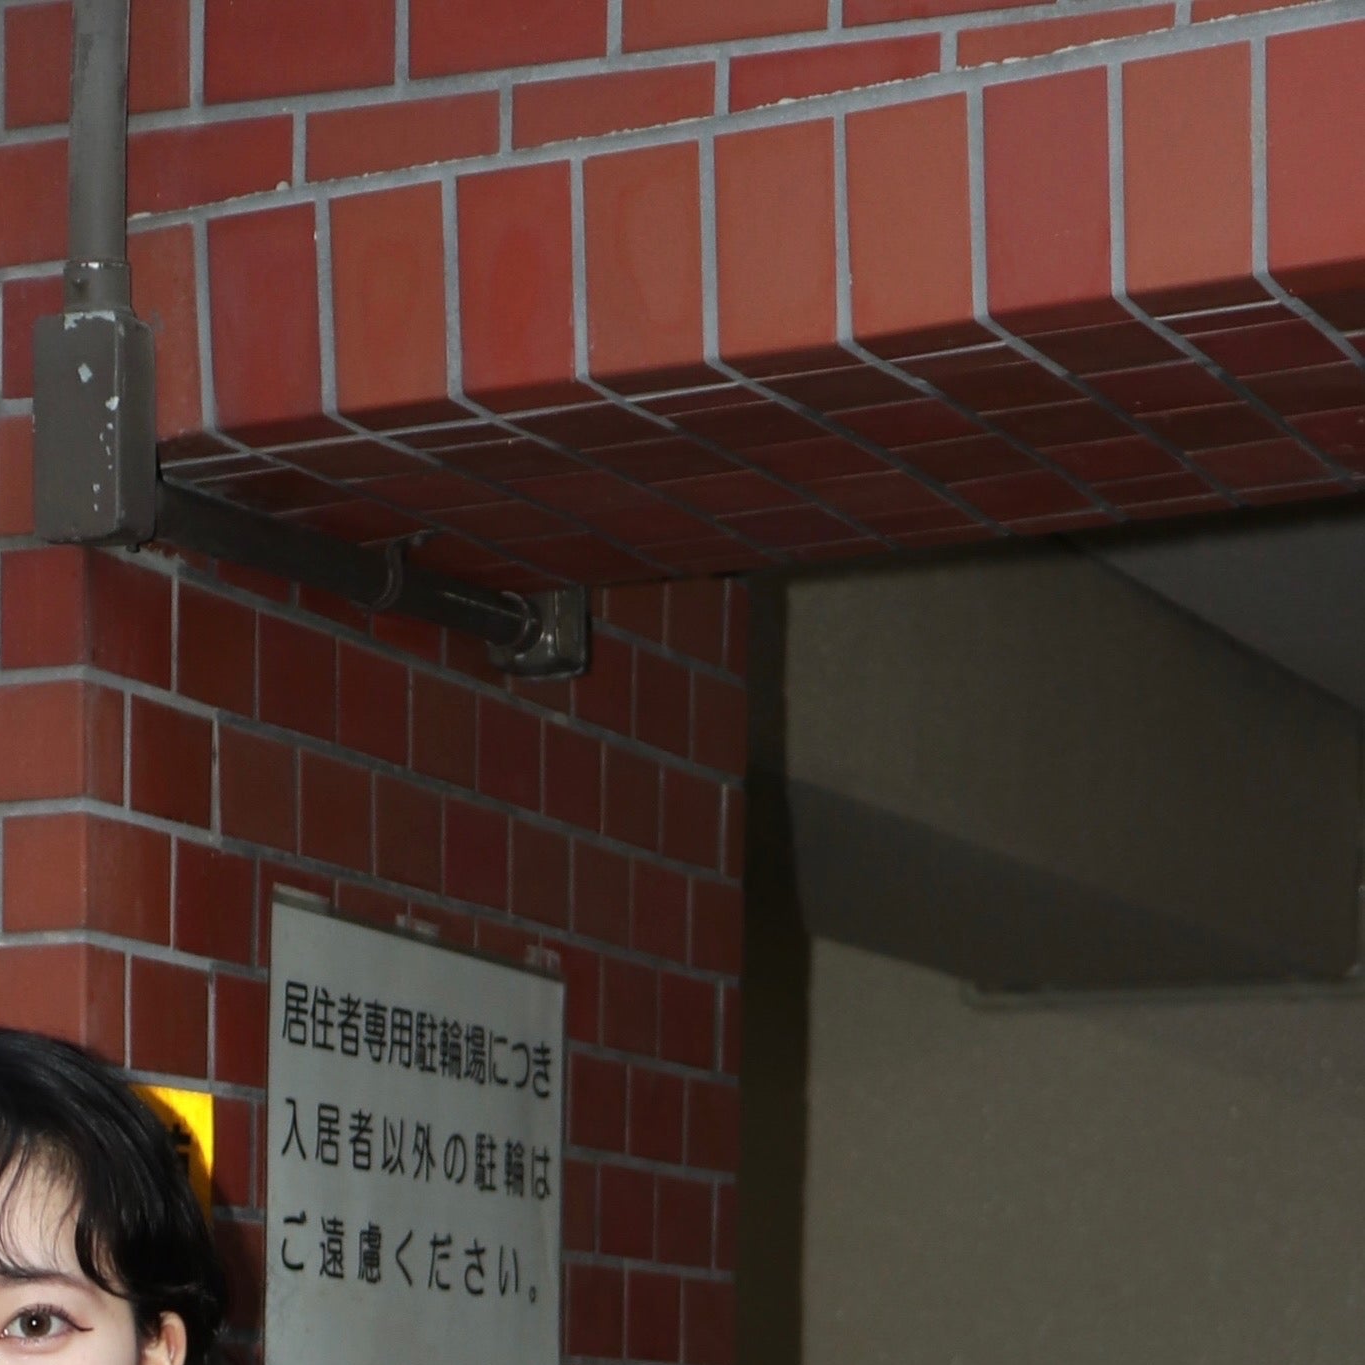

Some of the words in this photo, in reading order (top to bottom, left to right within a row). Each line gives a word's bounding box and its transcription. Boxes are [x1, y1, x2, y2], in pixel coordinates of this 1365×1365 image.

[282, 980, 552, 1099] 居住者専用駐輪場につき
[281, 1098, 552, 1201] 入居者以外の駐輪は
[281, 1210, 538, 1303] ご遠慮ください。
